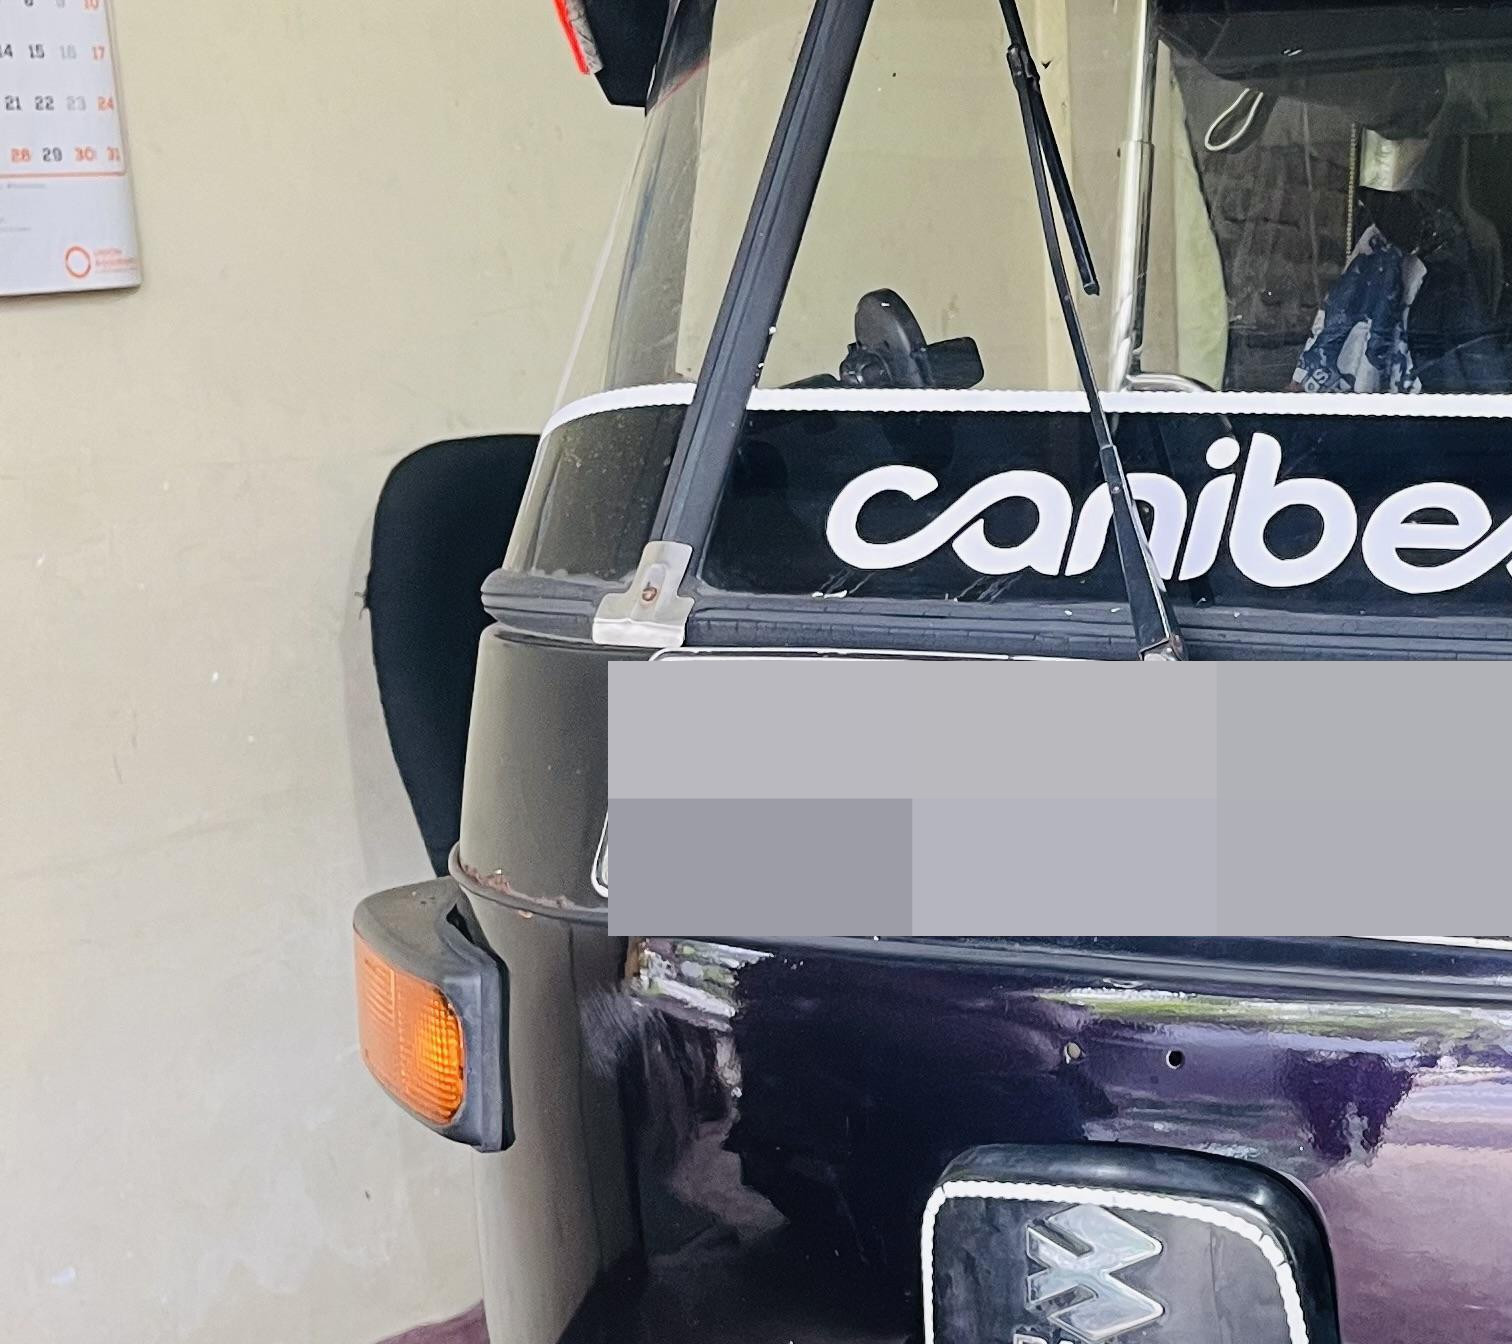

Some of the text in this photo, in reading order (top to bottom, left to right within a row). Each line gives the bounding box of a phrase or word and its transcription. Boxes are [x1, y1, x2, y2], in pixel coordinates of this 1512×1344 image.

[28, 43, 45, 60] 15
[92, 45, 105, 61] 17
[4, 95, 22, 112] 21
[34, 95, 55, 112] 22
[97, 96, 115, 112] 24
[41, 146, 63, 163] 29
[75, 146, 97, 162] 30
[106, 146, 121, 162] 31
